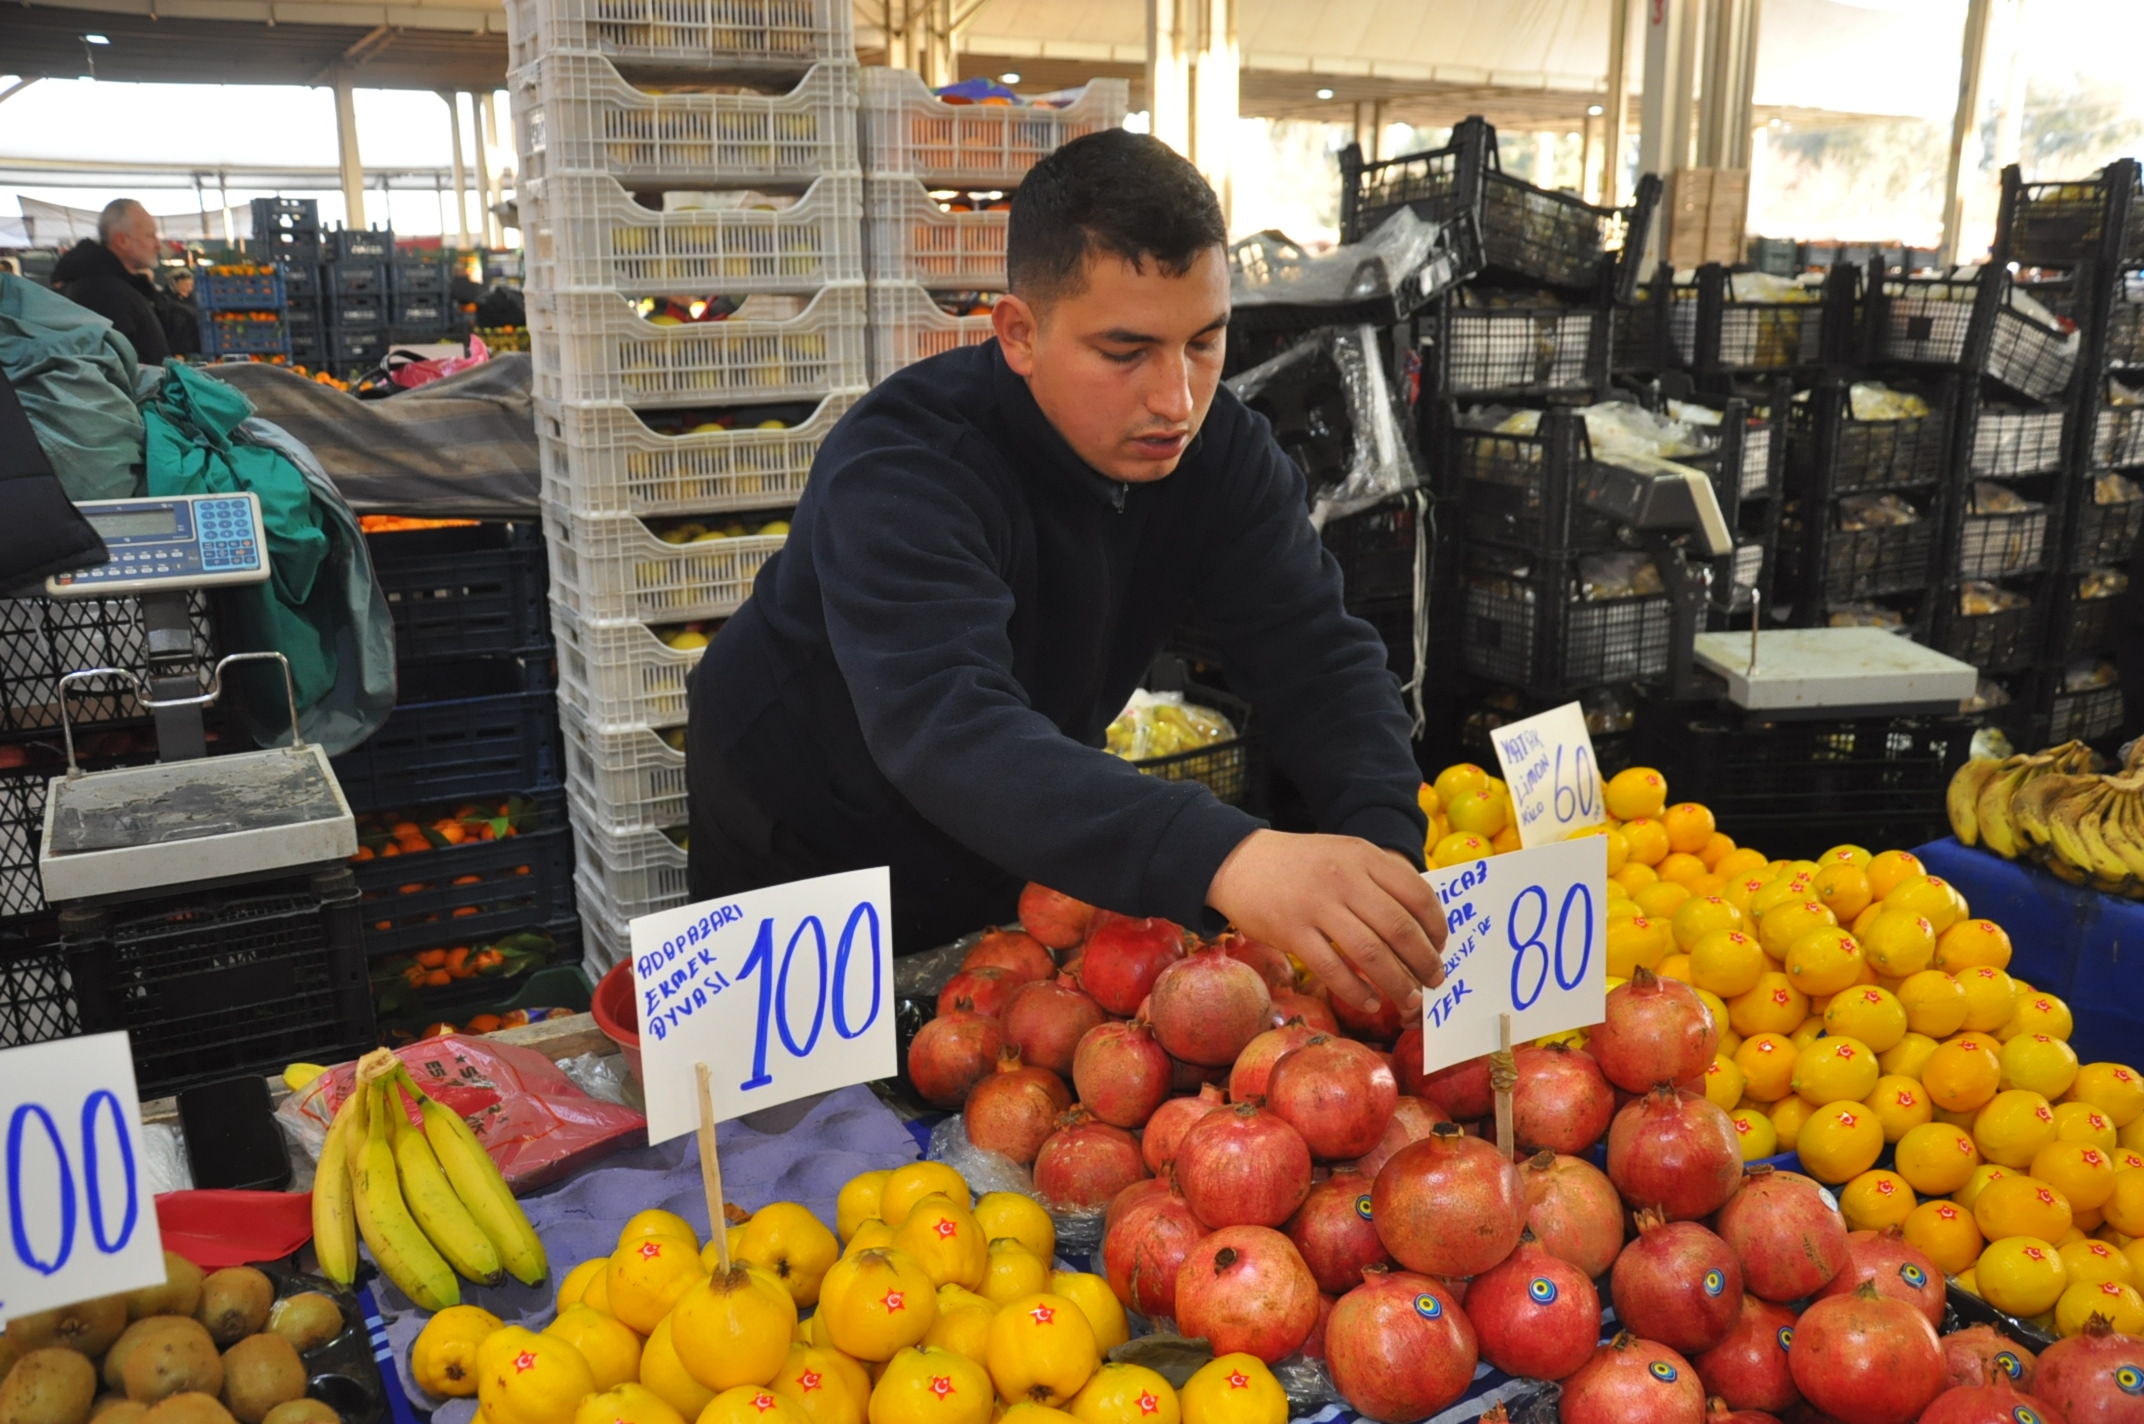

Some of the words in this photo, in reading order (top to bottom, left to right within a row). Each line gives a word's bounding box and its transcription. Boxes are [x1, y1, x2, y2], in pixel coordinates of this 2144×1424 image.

[1554, 744, 1593, 822] 60
[1436, 861, 1488, 905] İCAZ
[1447, 901, 1478, 935] AR
[1508, 883, 1594, 1011] 80
[645, 948, 718, 1017] EKMEK
[648, 970, 732, 1041] AYVASI
[736, 900, 883, 1092] 100
[1426, 978, 1473, 1028] TEK
